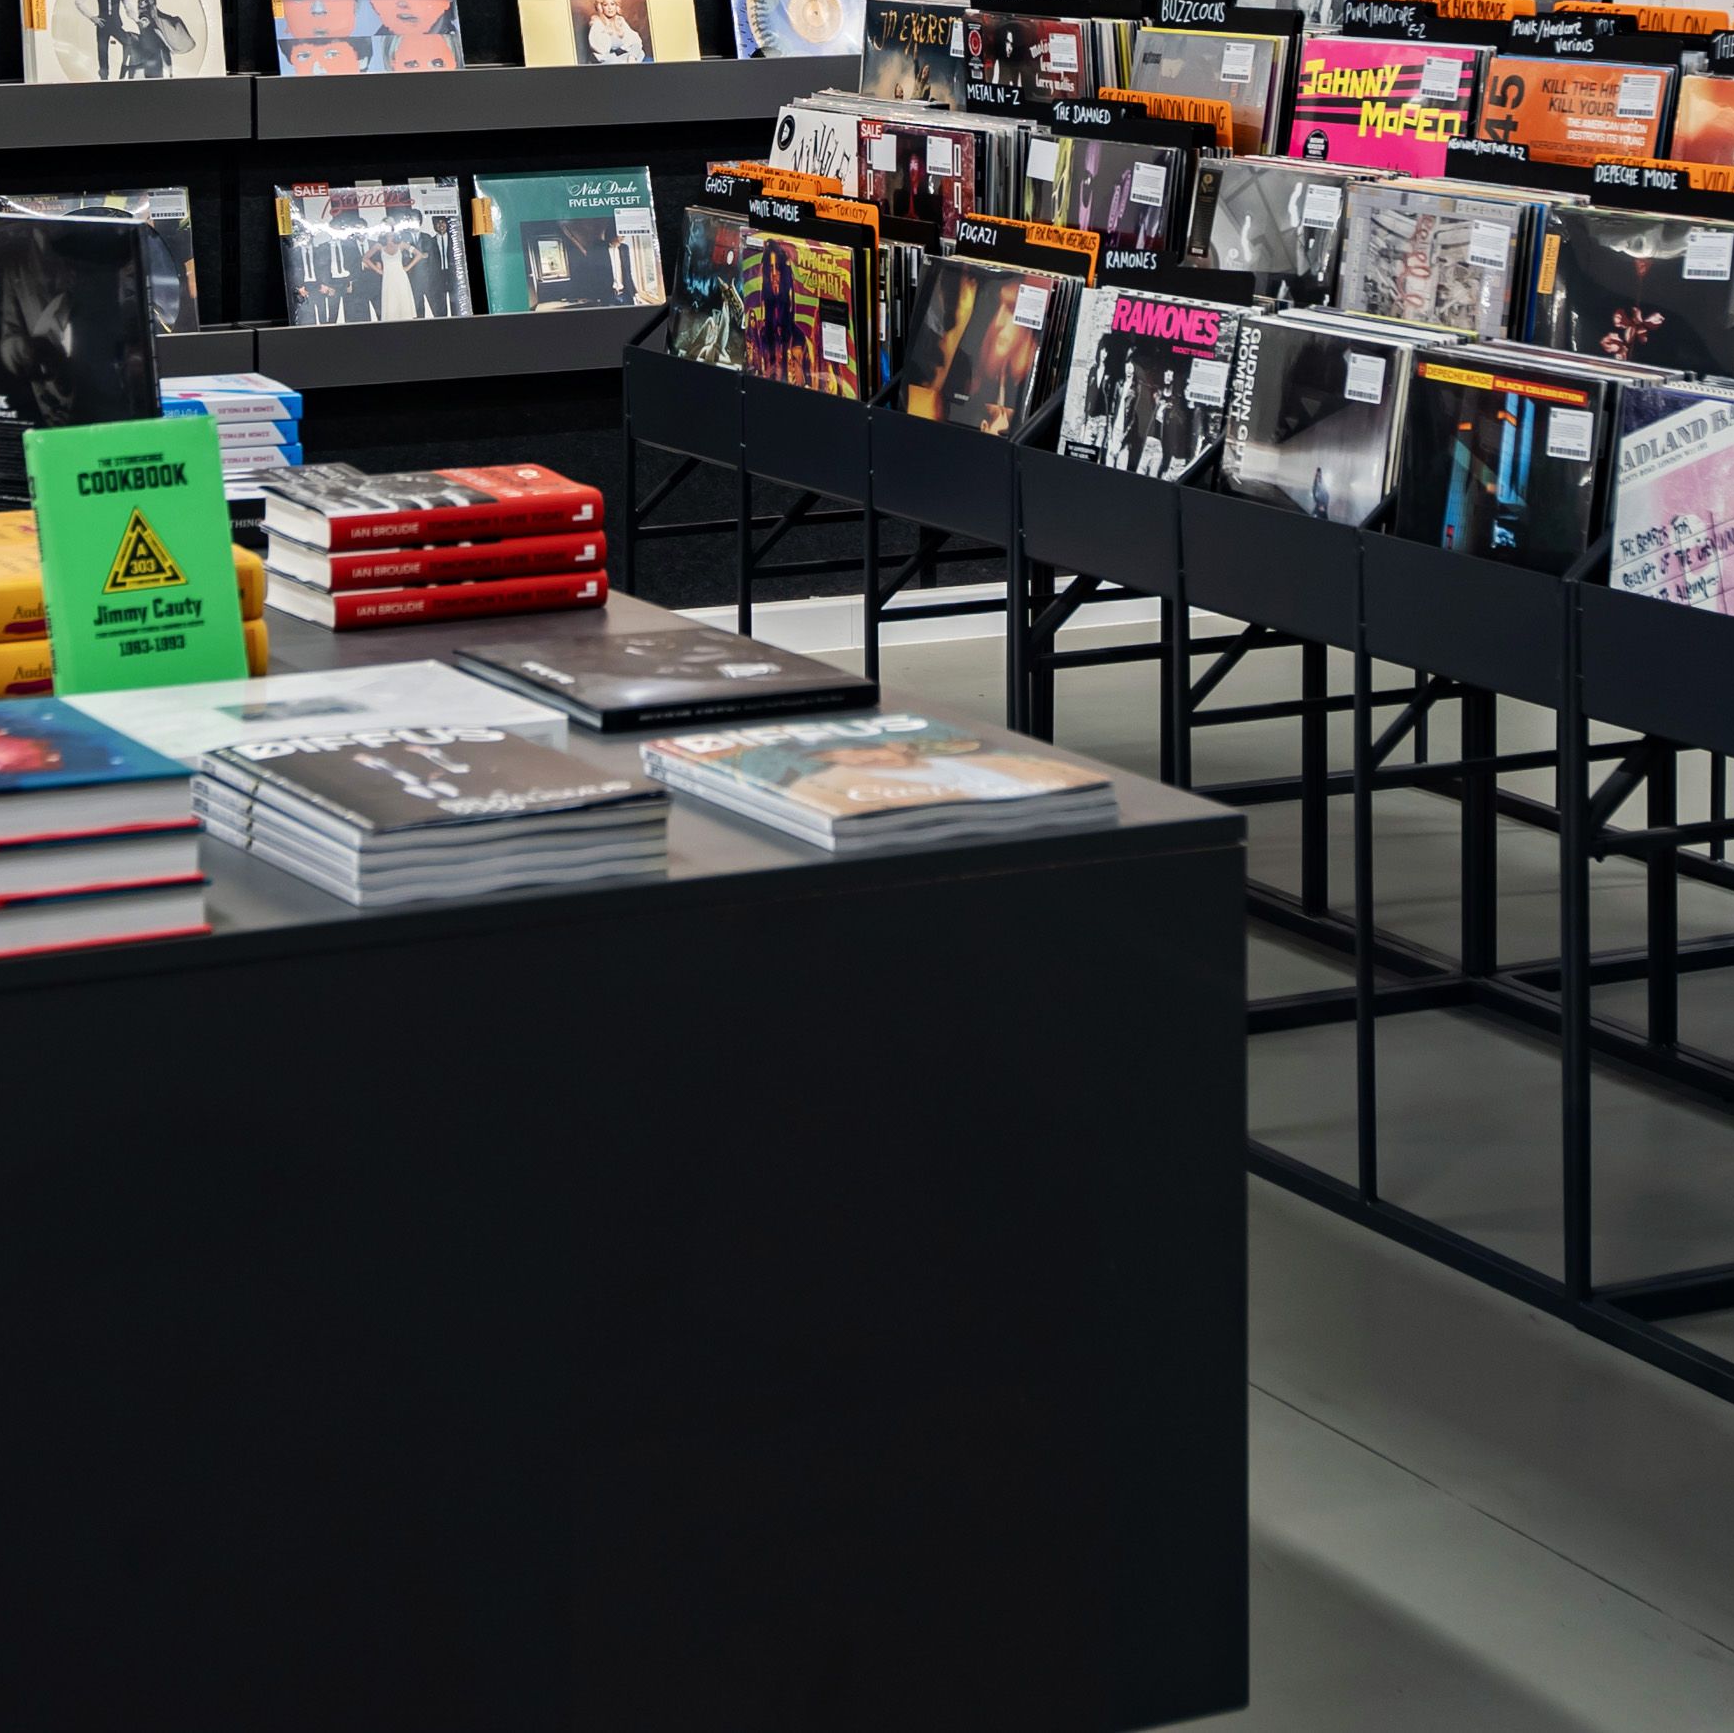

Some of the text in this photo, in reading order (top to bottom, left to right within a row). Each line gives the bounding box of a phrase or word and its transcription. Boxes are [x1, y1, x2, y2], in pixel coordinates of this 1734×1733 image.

[967, 83, 994, 103] METAL
[1053, 101, 1111, 124] THE DAMNED
[860, 122, 883, 137] SALE
[705, 177, 735, 194] GHOST
[1594, 165, 1678, 190] DEPECHE MODE
[293, 184, 328, 197] SALE
[569, 195, 641, 208] FIVE LEAVES LEFT
[771, 201, 800, 222] ZOMBIE
[960, 222, 997, 245] FUGAZI
[1106, 251, 1157, 269] RAMONES
[1114, 297, 1220, 346] RAMONES
[1239, 328, 1262, 421] GUDRUN
[77, 463, 188, 496] COOKBOOK
[351, 523, 419, 539] IAN BROUDIE
[94, 597, 202, 626] Jimmy Cauty
